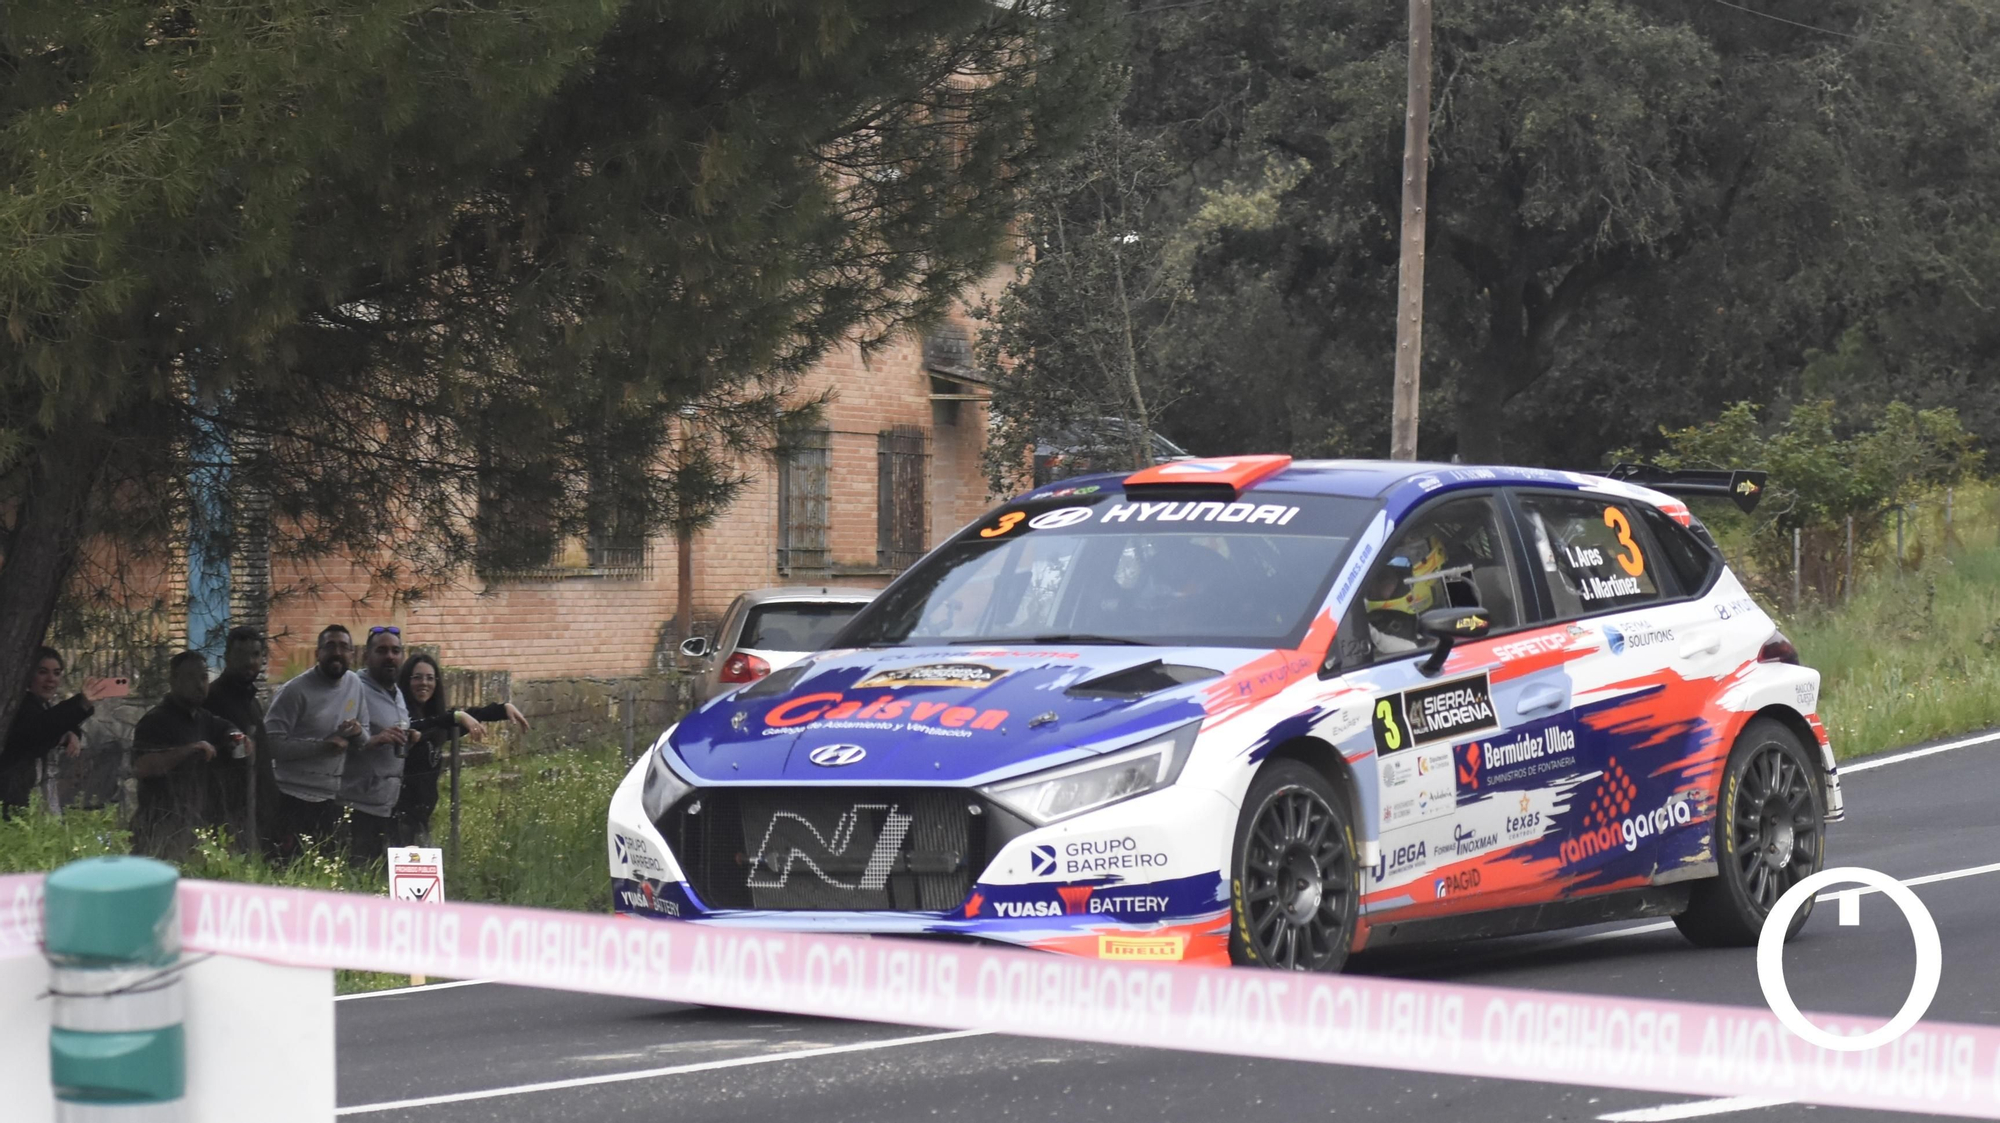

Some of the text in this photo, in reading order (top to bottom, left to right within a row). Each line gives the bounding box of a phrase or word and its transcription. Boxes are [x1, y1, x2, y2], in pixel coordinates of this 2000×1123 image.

[980, 502, 1300, 537] 3 HYUNDAI
[1604, 506, 1644, 577] 3
[1590, 573, 1641, 599] Martínez
[1629, 629, 1675, 648] SOLUTIONS
[1424, 688, 1475, 714] SIERRA
[1376, 700, 1401, 750] 3
[1426, 702, 1492, 732] MORENA
[1483, 733, 1545, 770] Bermúdez
[1544, 725, 1575, 754] Ulloa
[1527, 765, 1537, 776] DE
[1506, 811, 1541, 833] texas
[1066, 837, 1136, 857] GRUPO
[1067, 853, 1168, 874] BARREIRO
[993, 896, 1170, 918] YUASA BATTERY
[1105, 940, 1176, 956] PIRELLI
